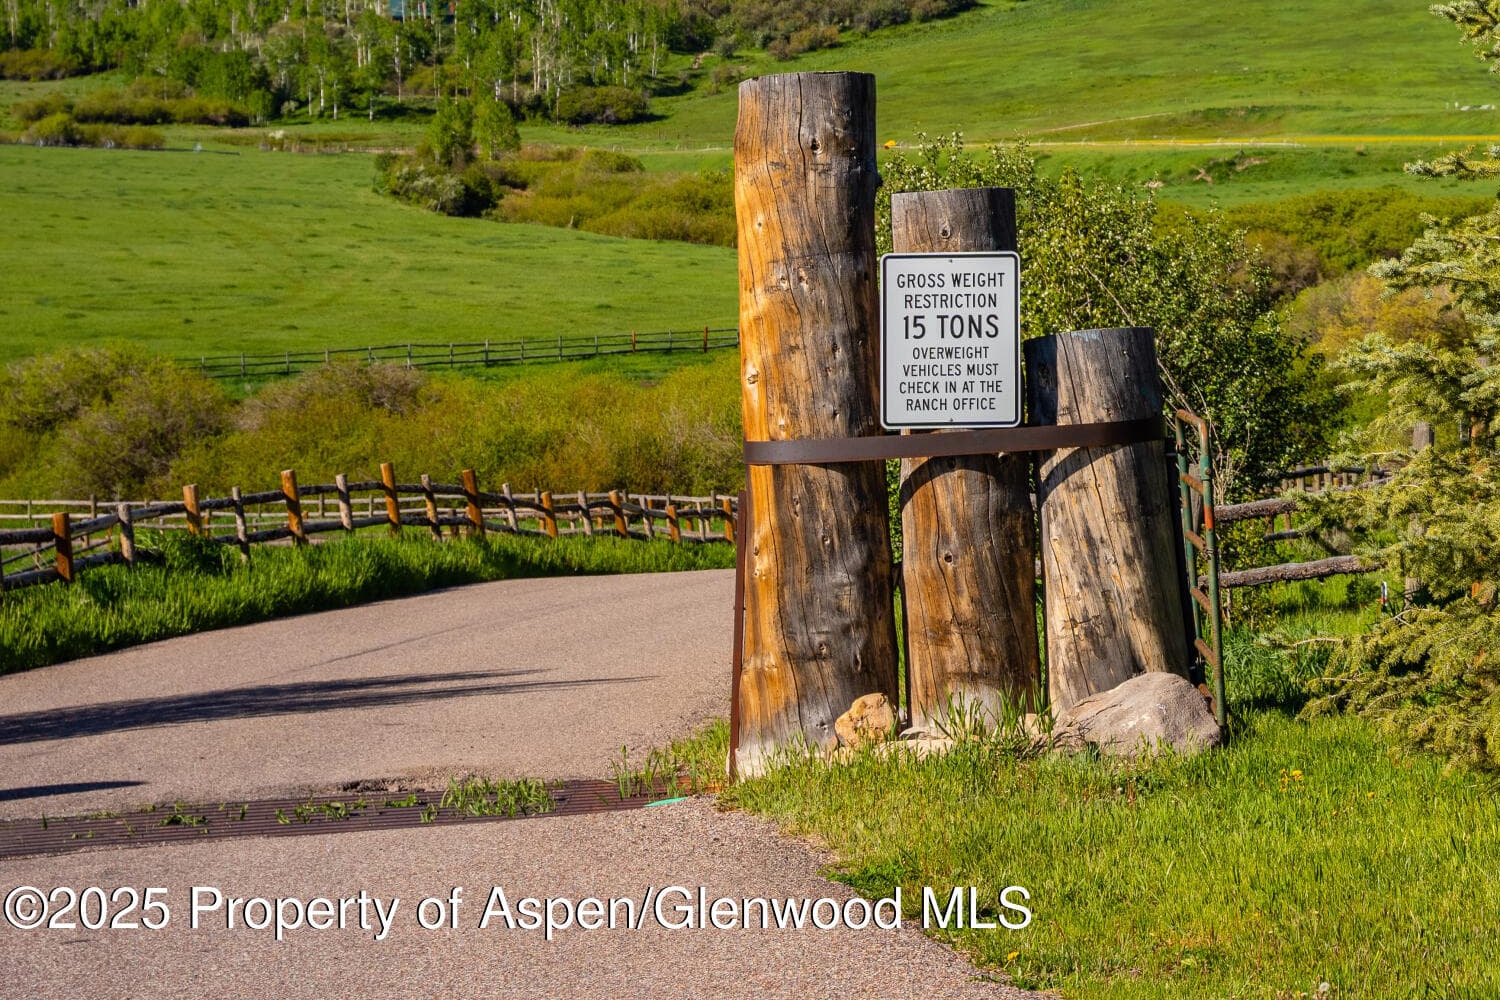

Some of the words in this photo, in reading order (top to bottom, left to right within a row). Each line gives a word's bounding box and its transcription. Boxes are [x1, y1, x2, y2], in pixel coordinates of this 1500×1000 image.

[897, 274, 944, 288] GROSS
[952, 273, 1005, 287] WEIGHT
[905, 294, 996, 308] RESTRICTION
[904, 316, 925, 339] 15
[937, 314, 998, 338] TONS
[913, 347, 989, 359] OVERWEIGHT
[903, 364, 961, 376] VEHICLES
[967, 363, 998, 375] MUST
[900, 382, 939, 394] CHECK
[946, 381, 956, 393] IN
[963, 381, 975, 393] AT
[980, 381, 1002, 392] THE
[907, 398, 947, 411] RANCH
[953, 398, 995, 410] OFFICE
